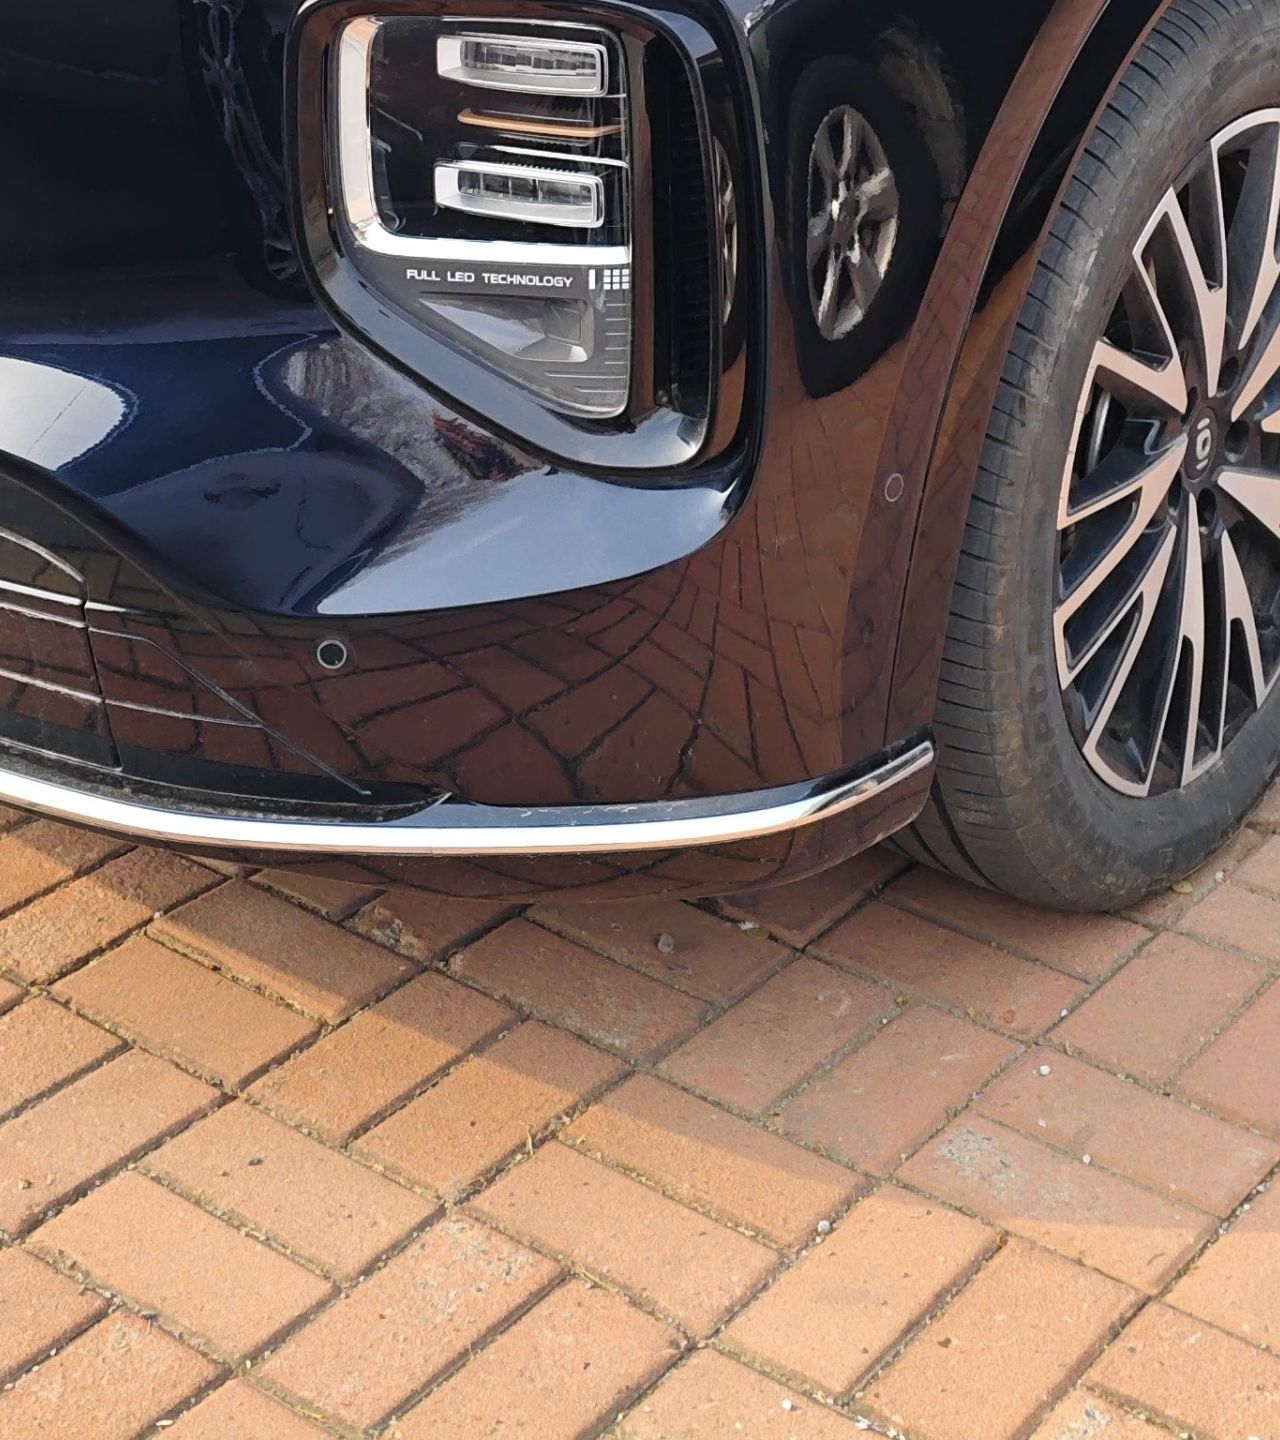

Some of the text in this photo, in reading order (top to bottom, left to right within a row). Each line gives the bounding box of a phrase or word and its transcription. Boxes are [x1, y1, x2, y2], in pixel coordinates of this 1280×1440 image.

[406, 269, 573, 288] FULL LED TECHNOLOGY
